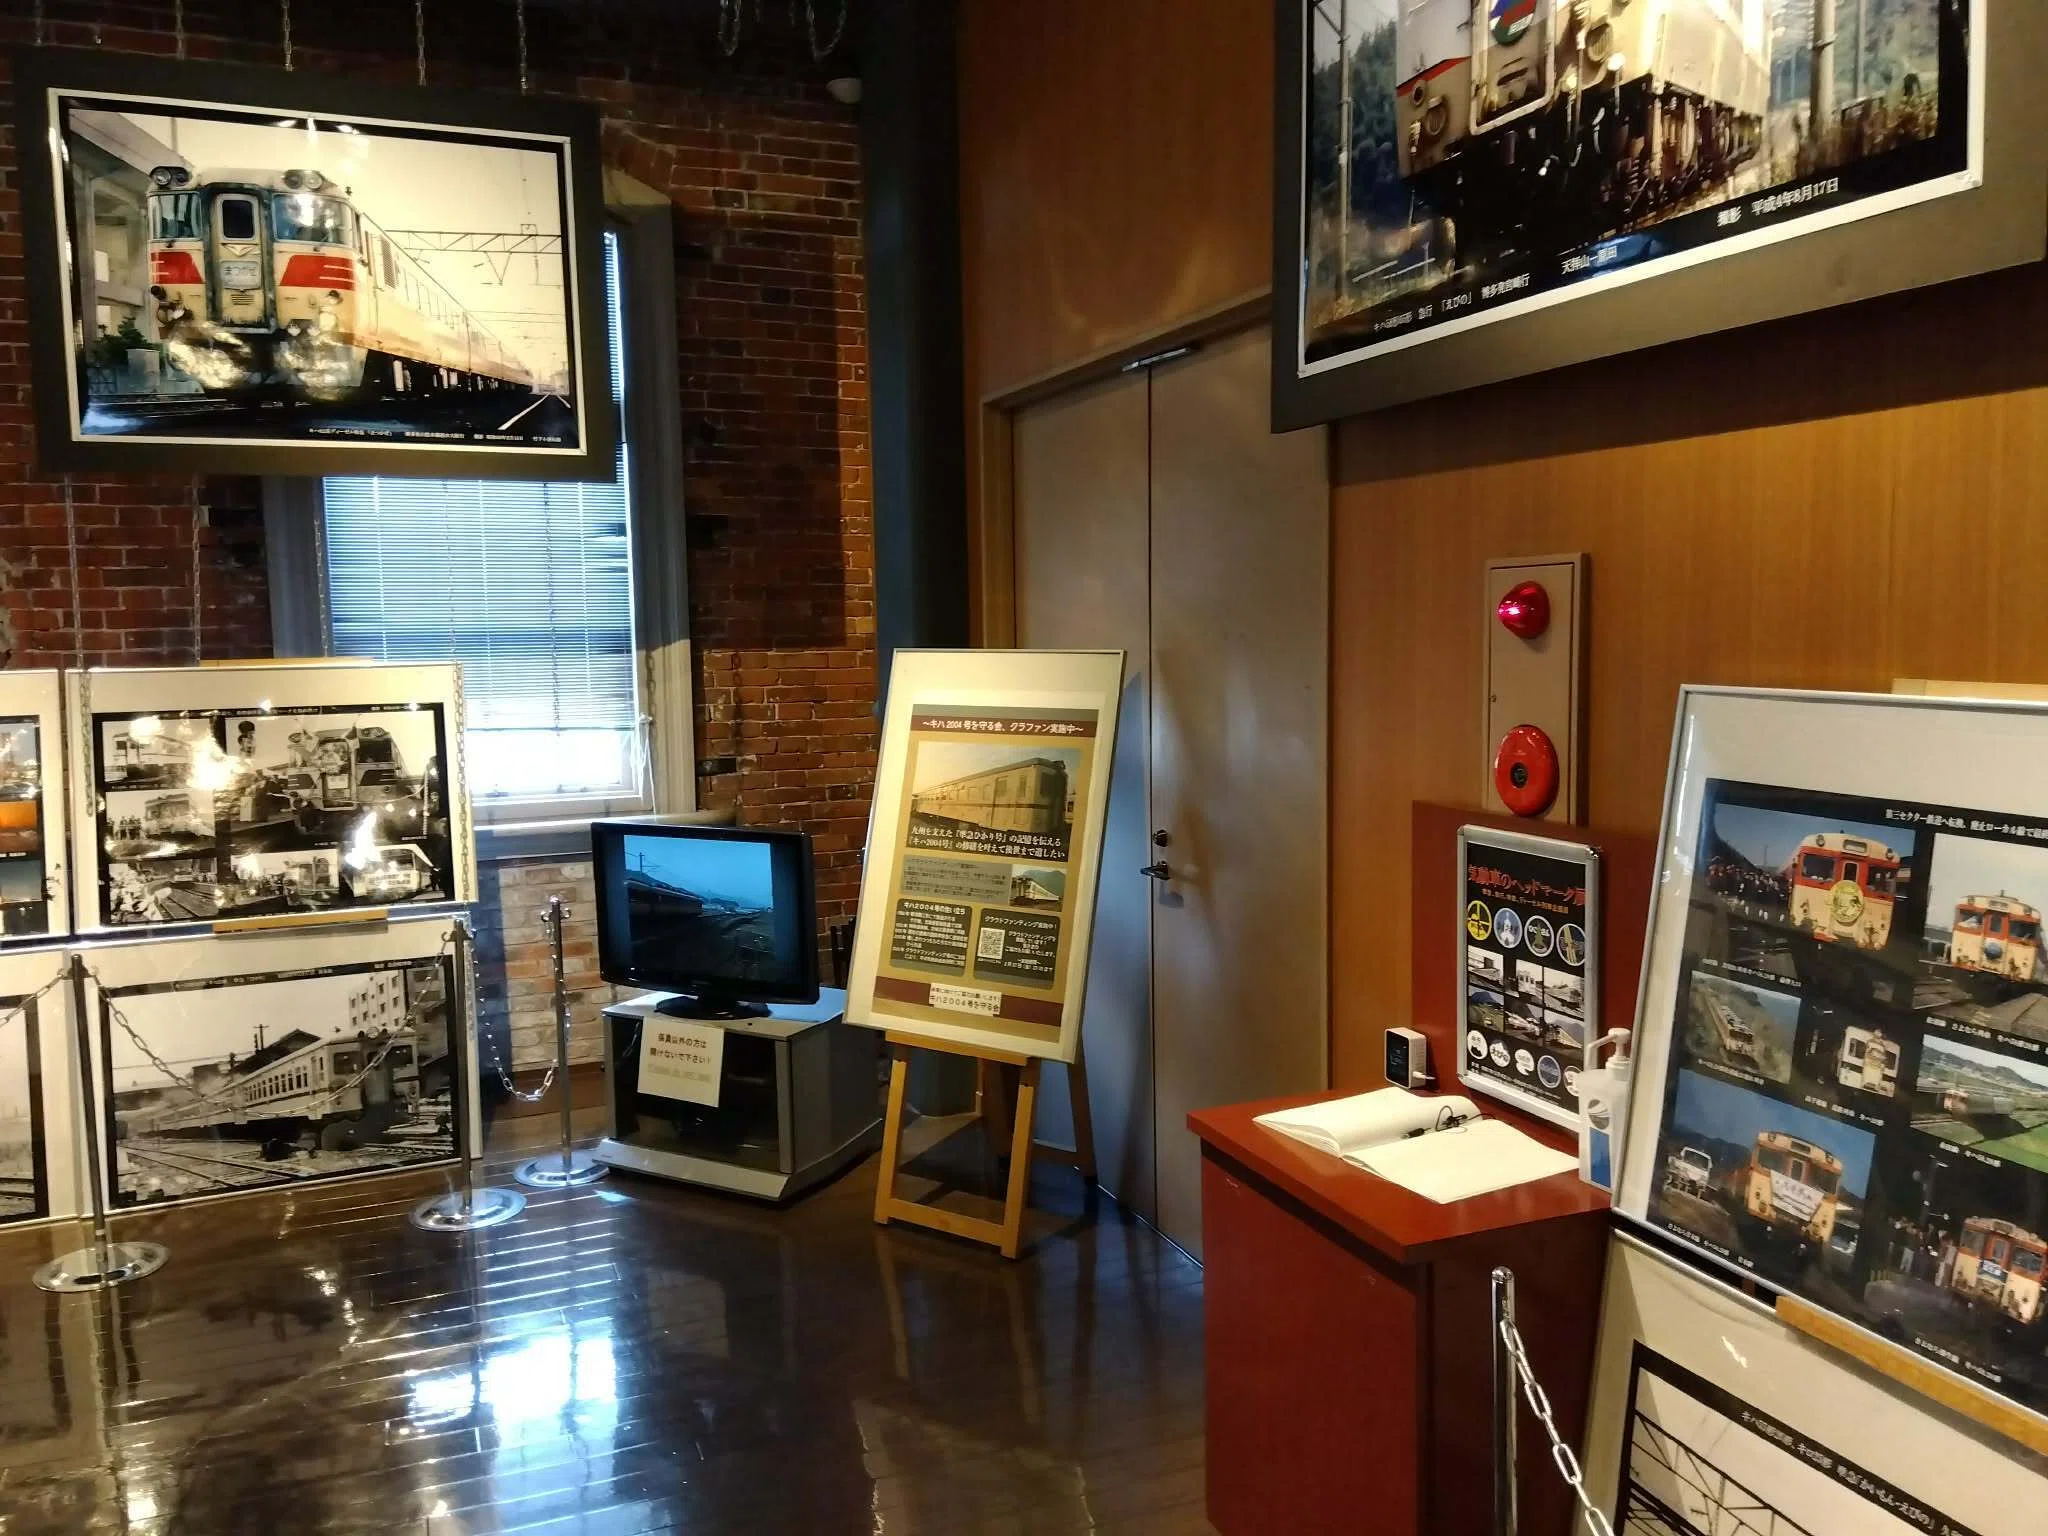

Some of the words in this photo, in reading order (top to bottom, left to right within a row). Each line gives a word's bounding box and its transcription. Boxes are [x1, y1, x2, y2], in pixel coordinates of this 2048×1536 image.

[1751, 177, 1840, 217] 平成4年8月17日
